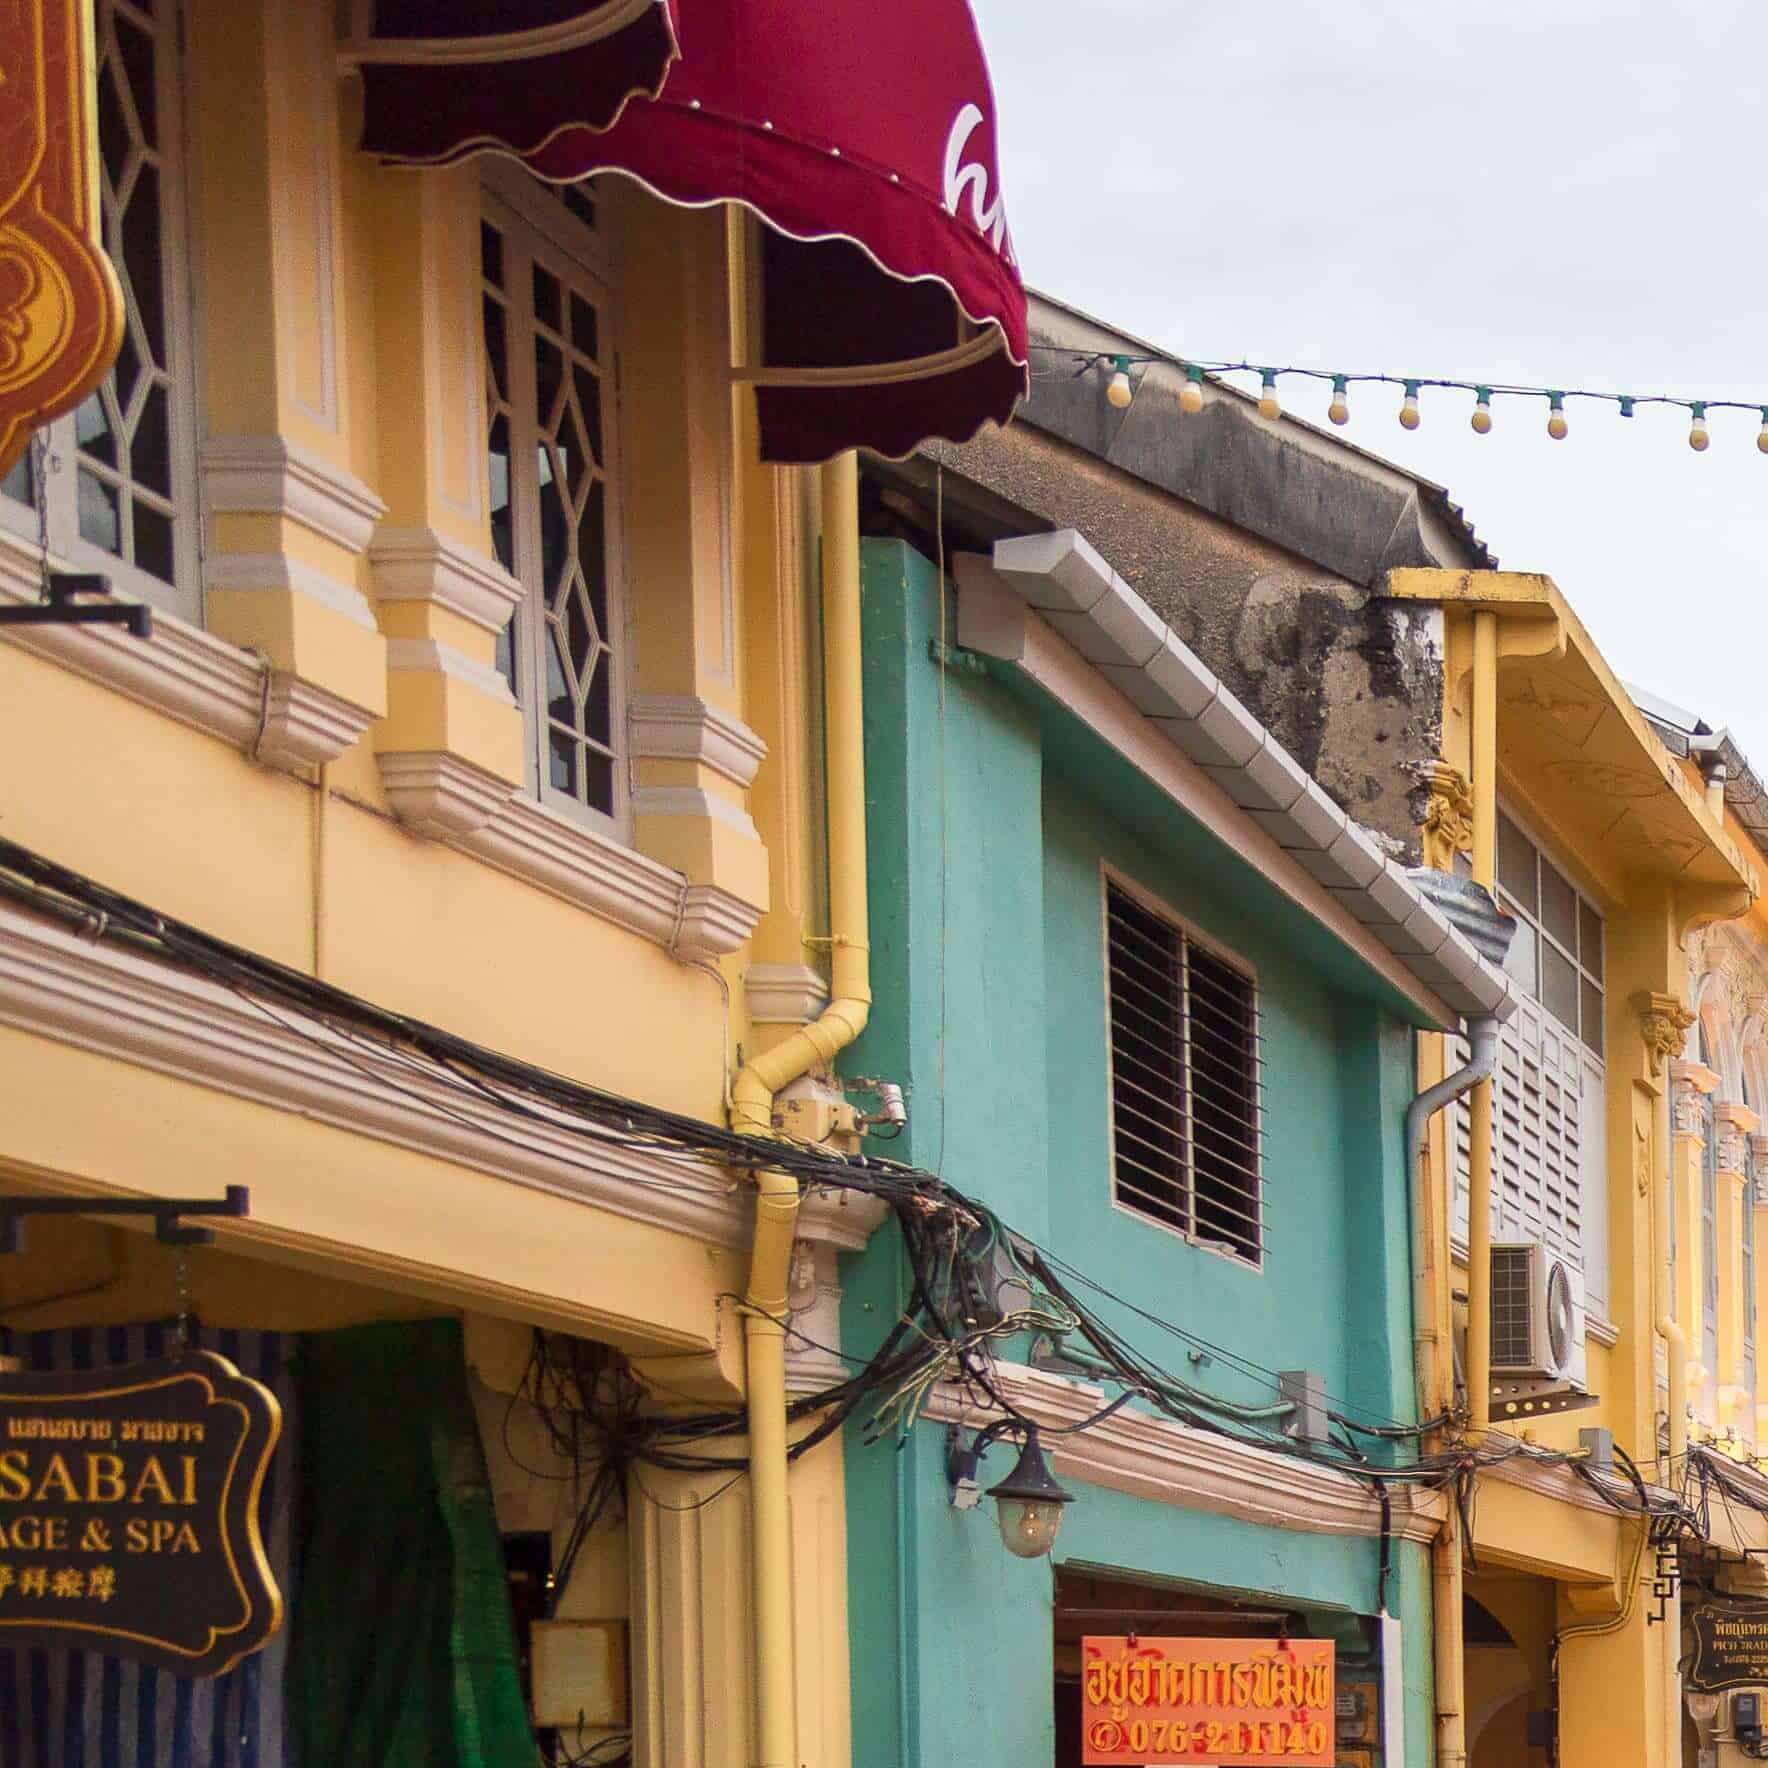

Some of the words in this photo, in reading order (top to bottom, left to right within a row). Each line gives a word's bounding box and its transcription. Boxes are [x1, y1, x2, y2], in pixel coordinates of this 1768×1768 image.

[0, 1451, 199, 1506] SABAI
[80, 1518, 113, 1552] &
[126, 1519, 201, 1553] SPA
[1128, 1719, 1328, 1754] 076-211140
